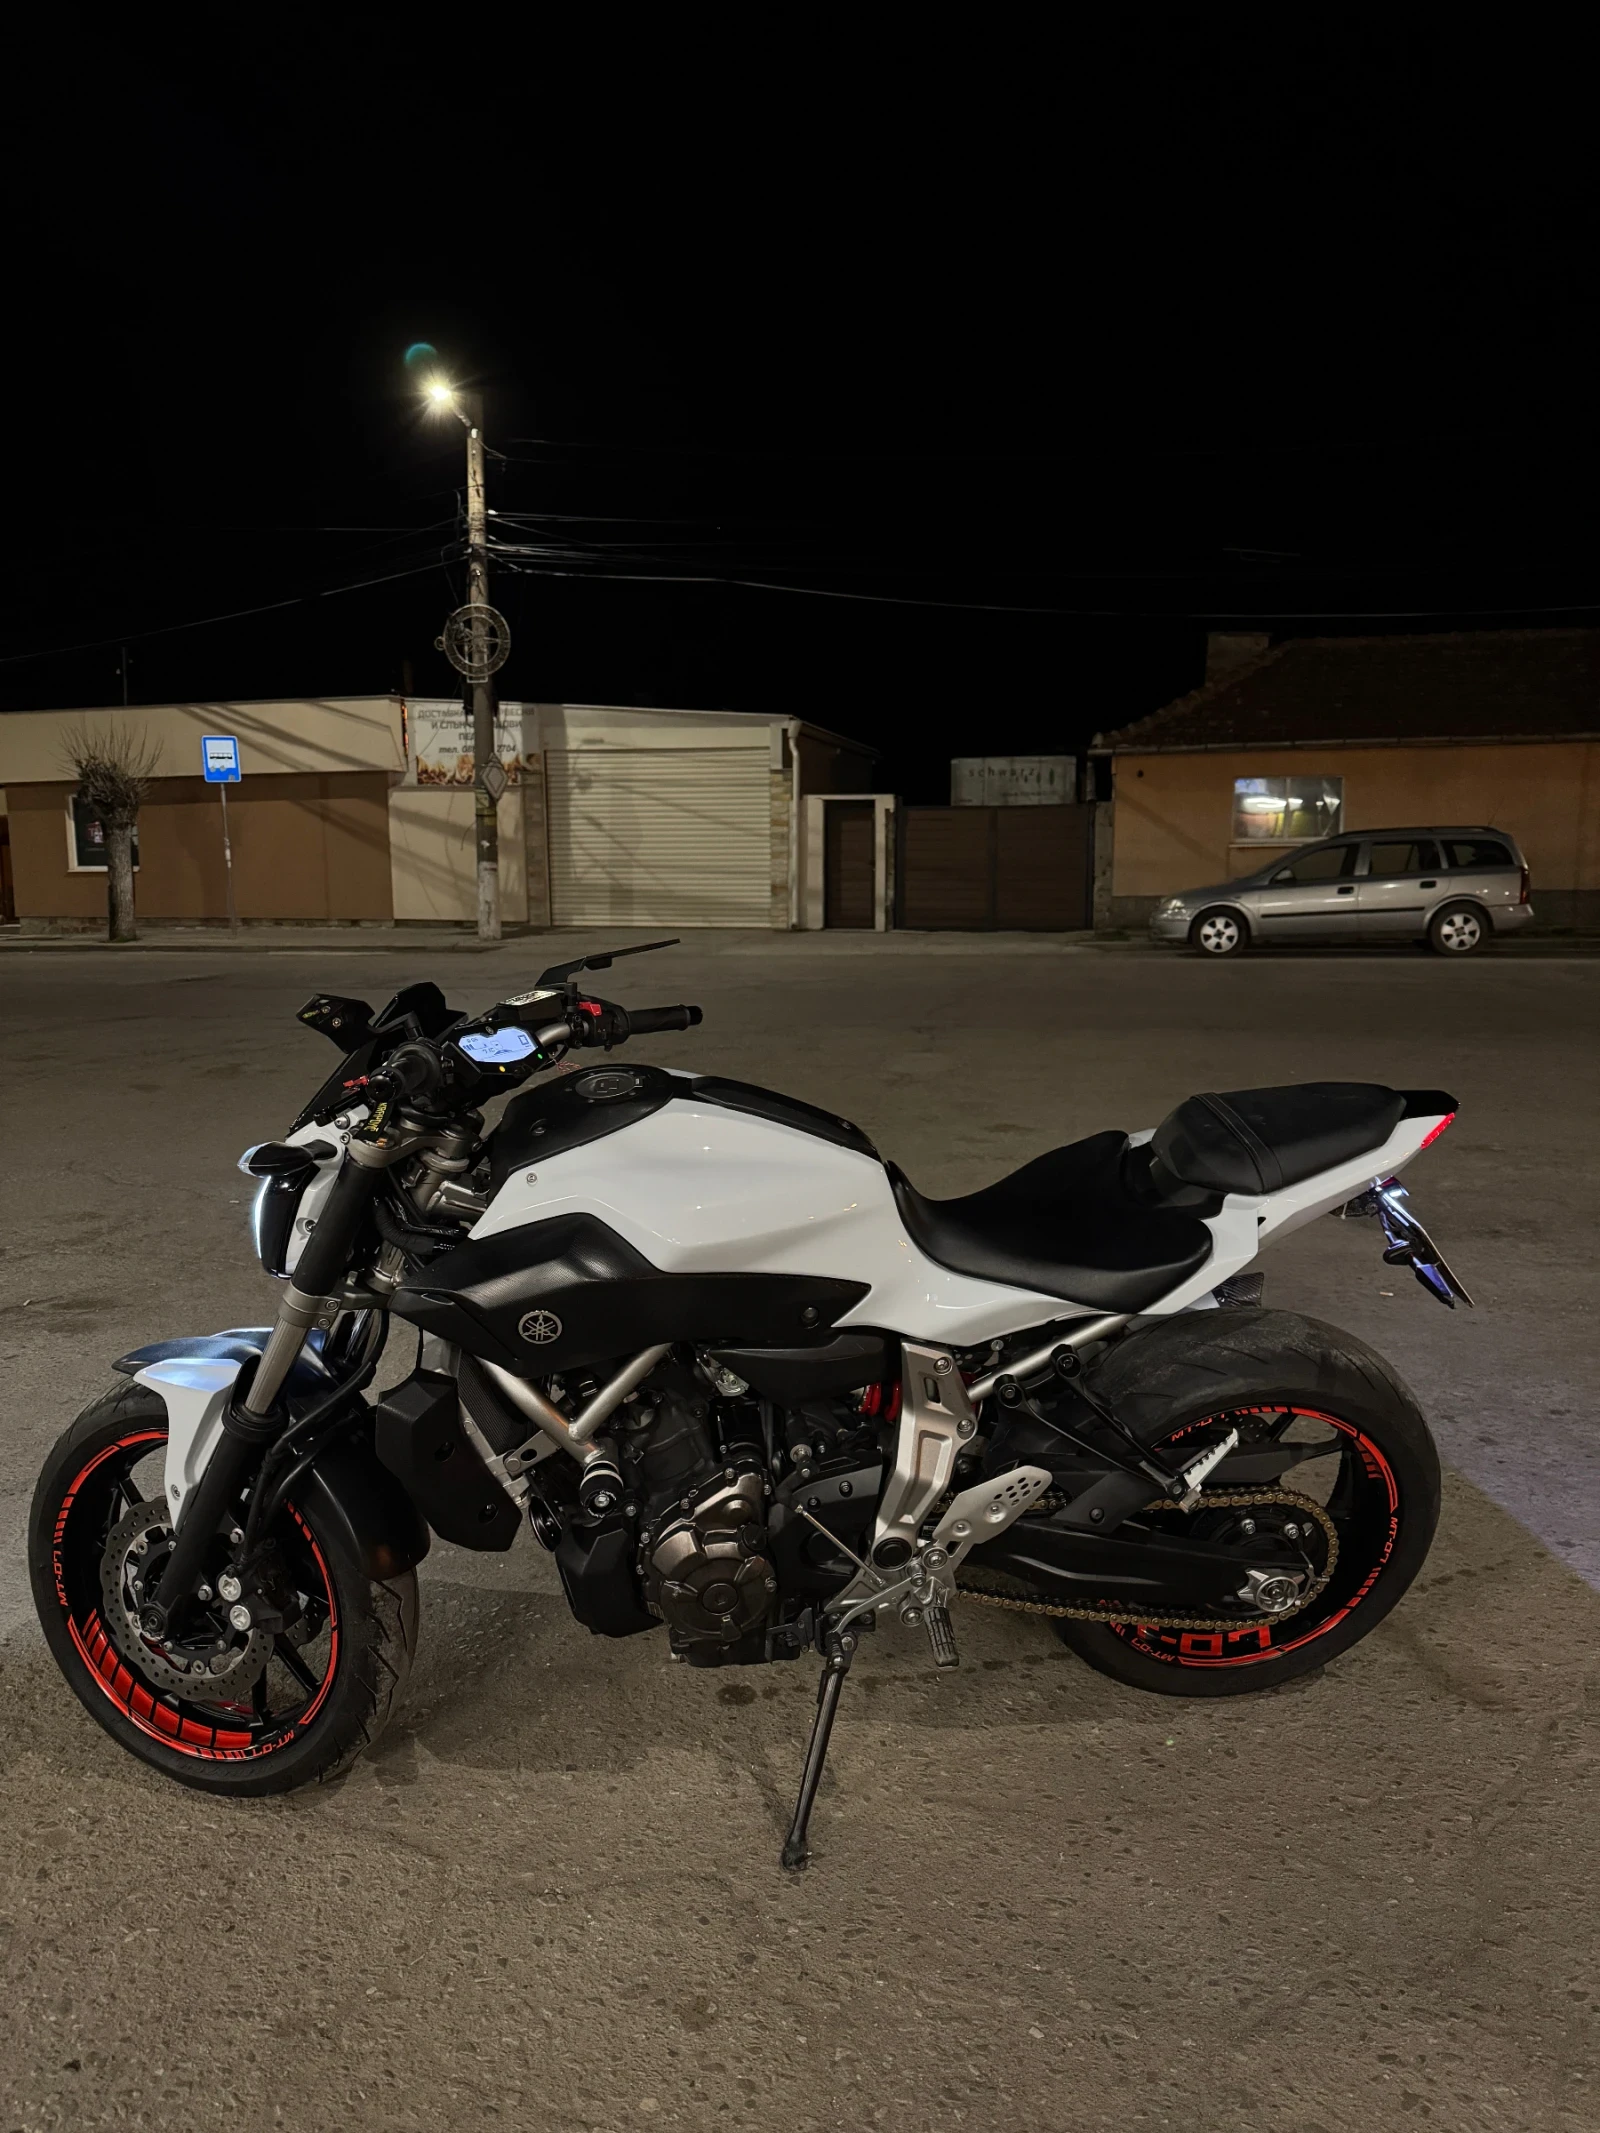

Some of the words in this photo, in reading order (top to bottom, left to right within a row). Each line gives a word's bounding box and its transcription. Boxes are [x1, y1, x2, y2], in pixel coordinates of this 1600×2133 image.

[968, 766, 1035, 778] schwarz
[1379, 1516, 1399, 1564] MT-07
[52, 1550, 69, 1607] MT-07
[1131, 1637, 1175, 1662] MT-07
[251, 1729, 294, 1757] MT-07
